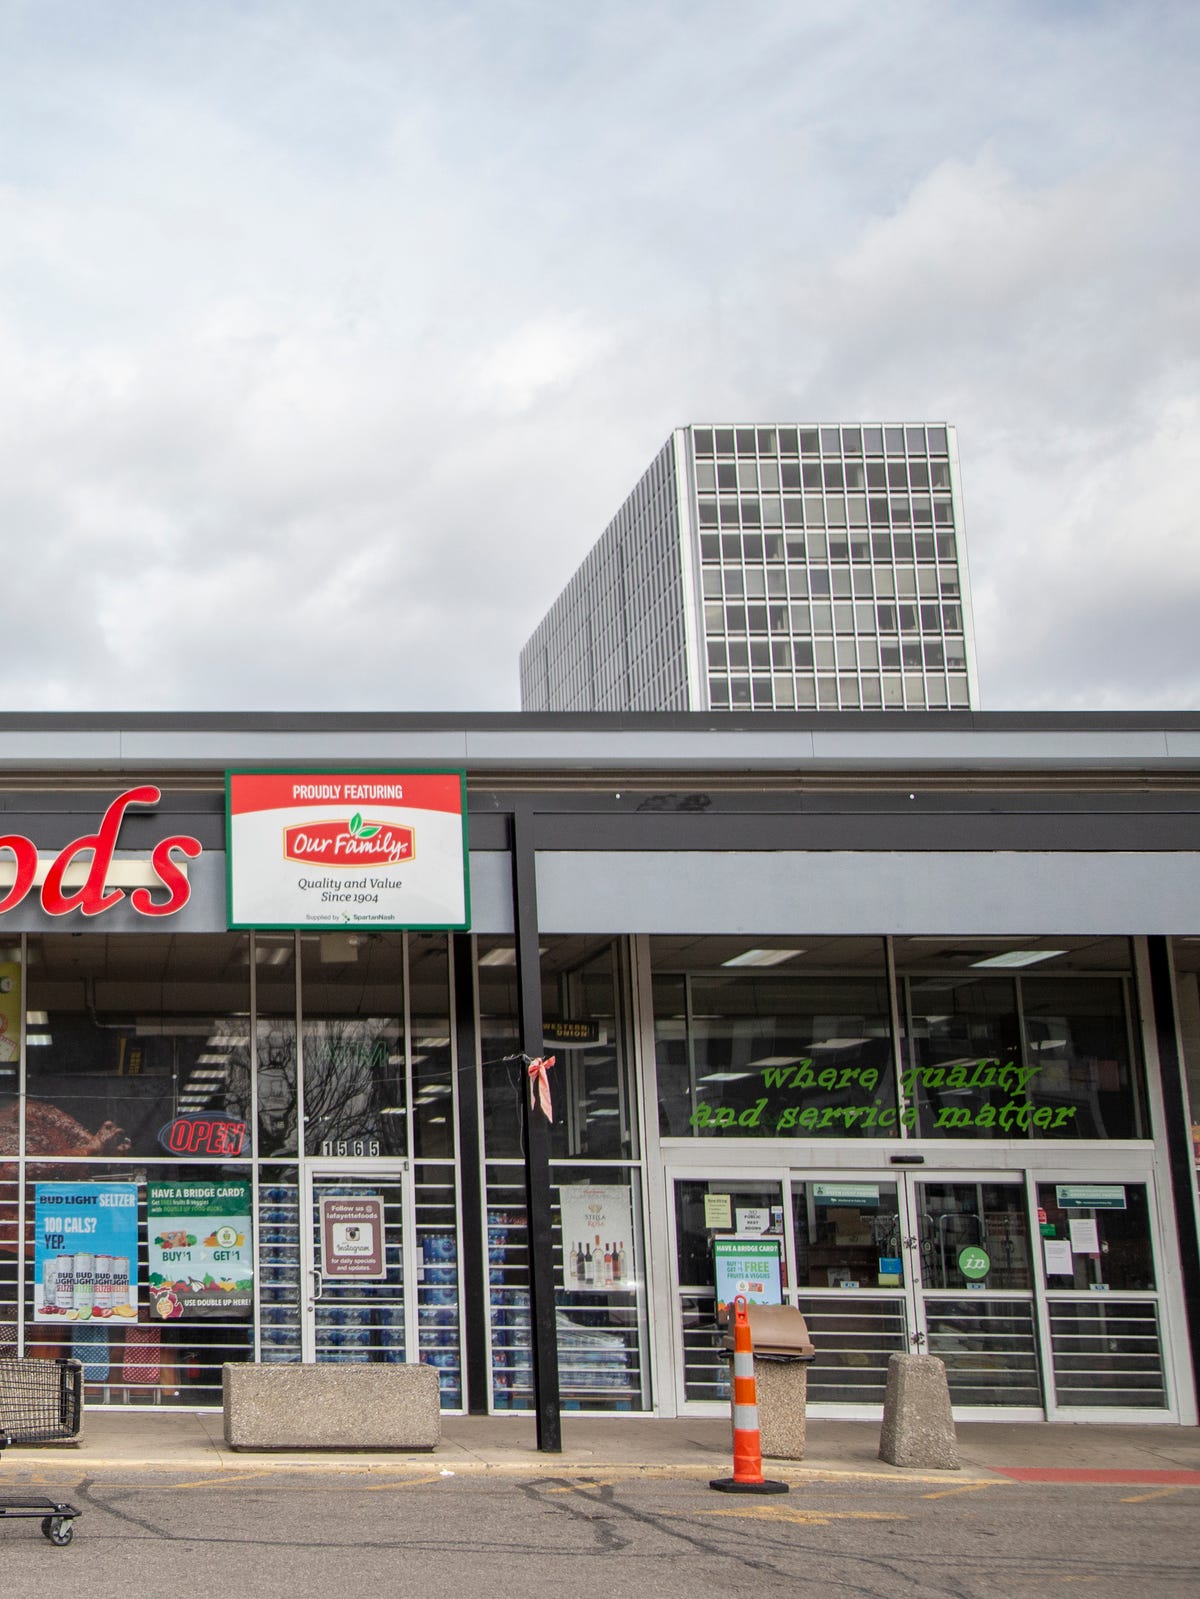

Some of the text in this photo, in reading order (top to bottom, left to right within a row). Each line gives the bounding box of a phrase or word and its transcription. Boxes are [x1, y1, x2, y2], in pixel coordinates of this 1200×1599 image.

[293, 784, 403, 799] PROUDLY FEATURING
[294, 831, 408, 862] Our Family
[297, 878, 402, 891] Quality and Value
[321, 891, 378, 903] Since 1904
[332, 914, 340, 922] by
[760, 1058, 1042, 1096] where quality
[689, 1098, 1077, 1131] and service matter
[169, 1119, 246, 1155] OPEN
[324, 1142, 379, 1156] 1565
[151, 1187, 245, 1198] HAVE A BRIDGE CARD?
[40, 1194, 135, 1207] BUD LIGHT SELTZER
[44, 1217, 97, 1233] 100 CALS?
[44, 1234, 66, 1250] YEP.
[162, 1251, 182, 1261] BUY
[213, 1250, 231, 1261] GET
[341, 1257, 353, 1265] daily
[354, 1257, 376, 1265] specials
[964, 1254, 986, 1269] in
[744, 1261, 770, 1273] FREE
[184, 1298, 251, 1307] USE DOUBLE UP HERE!
